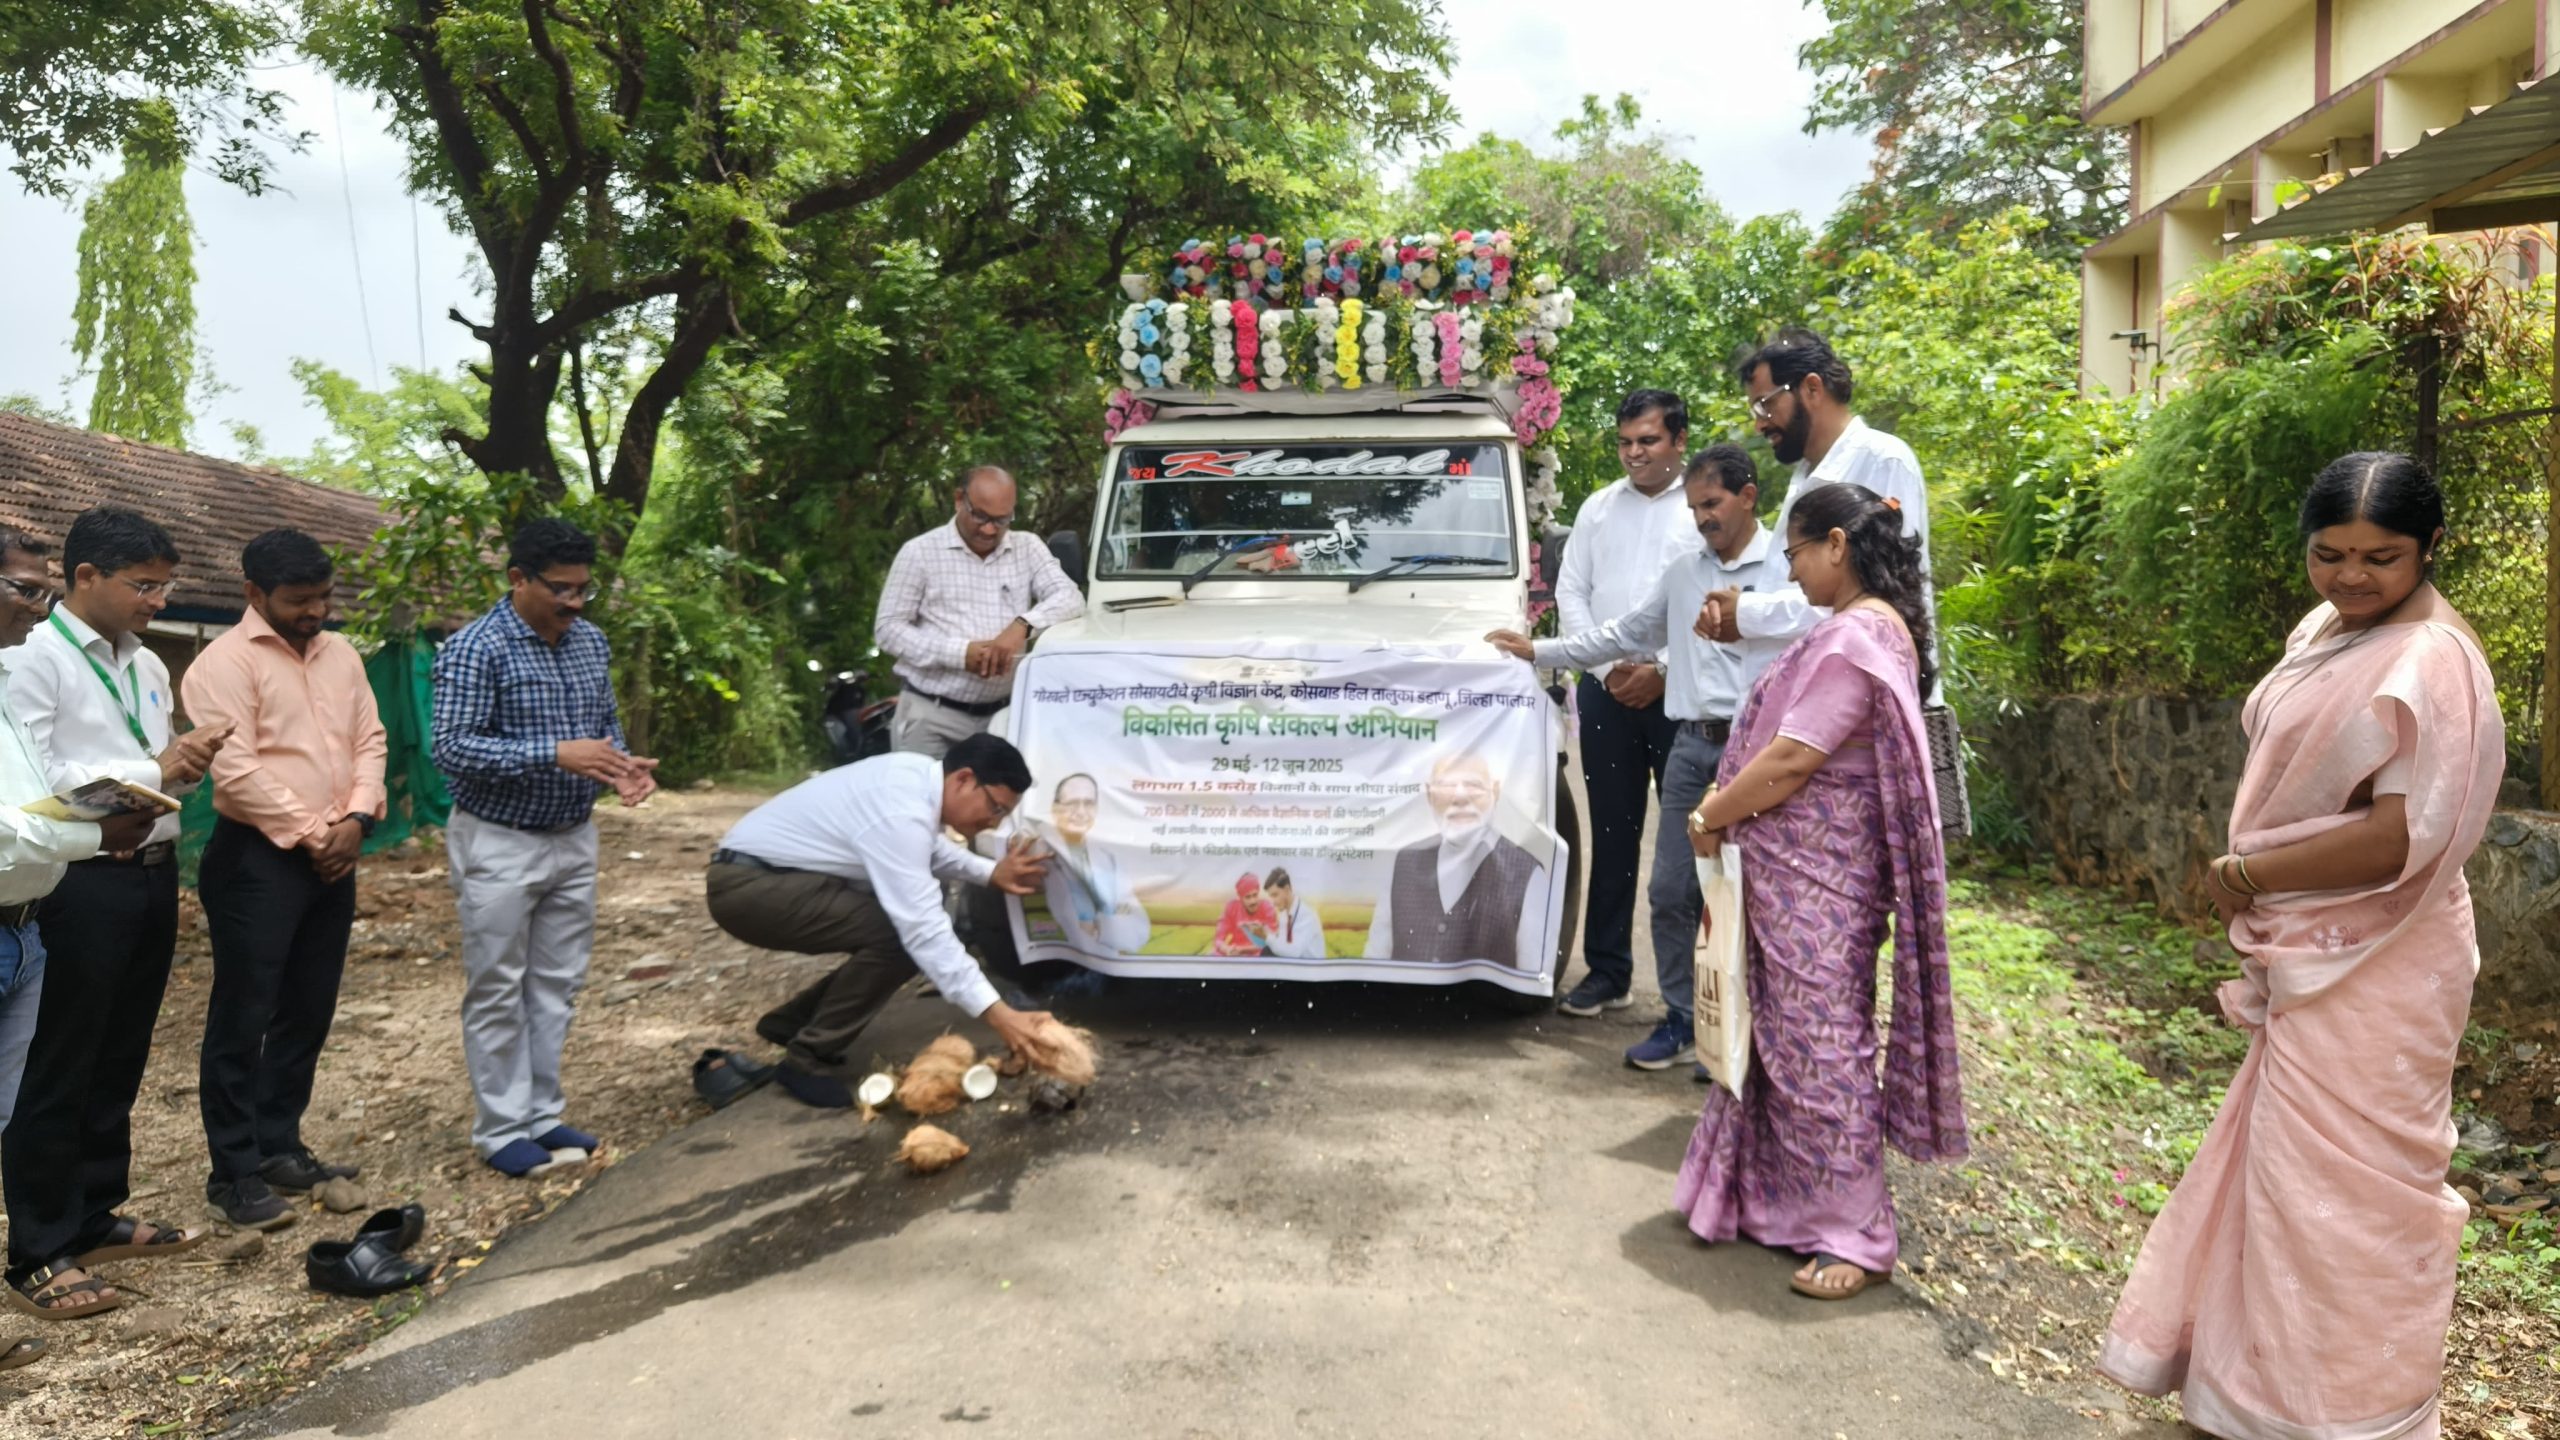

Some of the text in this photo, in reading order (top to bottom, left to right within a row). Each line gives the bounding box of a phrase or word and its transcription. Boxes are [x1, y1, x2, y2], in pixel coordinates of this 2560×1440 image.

[1161, 449, 1450, 478] Khodal
[1033, 686, 1070, 703] गोखले
[1129, 683, 1188, 700] सोसायटीचे
[1191, 681, 1217, 703] कृषी
[1220, 681, 1257, 698] विज्ञान
[1290, 680, 1340, 700] कोसबाड
[1343, 682, 1368, 701] हिल
[1372, 687, 1414, 705] तालुका
[1496, 692, 1536, 710] पालघर
[1122, 705, 1439, 744] विकसित कृषि संकल्प अभियान
[1211, 758, 1229, 772] 29
[1231, 755, 1252, 773] मई
[1263, 758, 1280, 772] 12
[1282, 759, 1305, 776] जून
[1307, 759, 1343, 773] 2025
[1131, 779, 1183, 792] लगभग
[1189, 781, 1213, 792] 1.5
